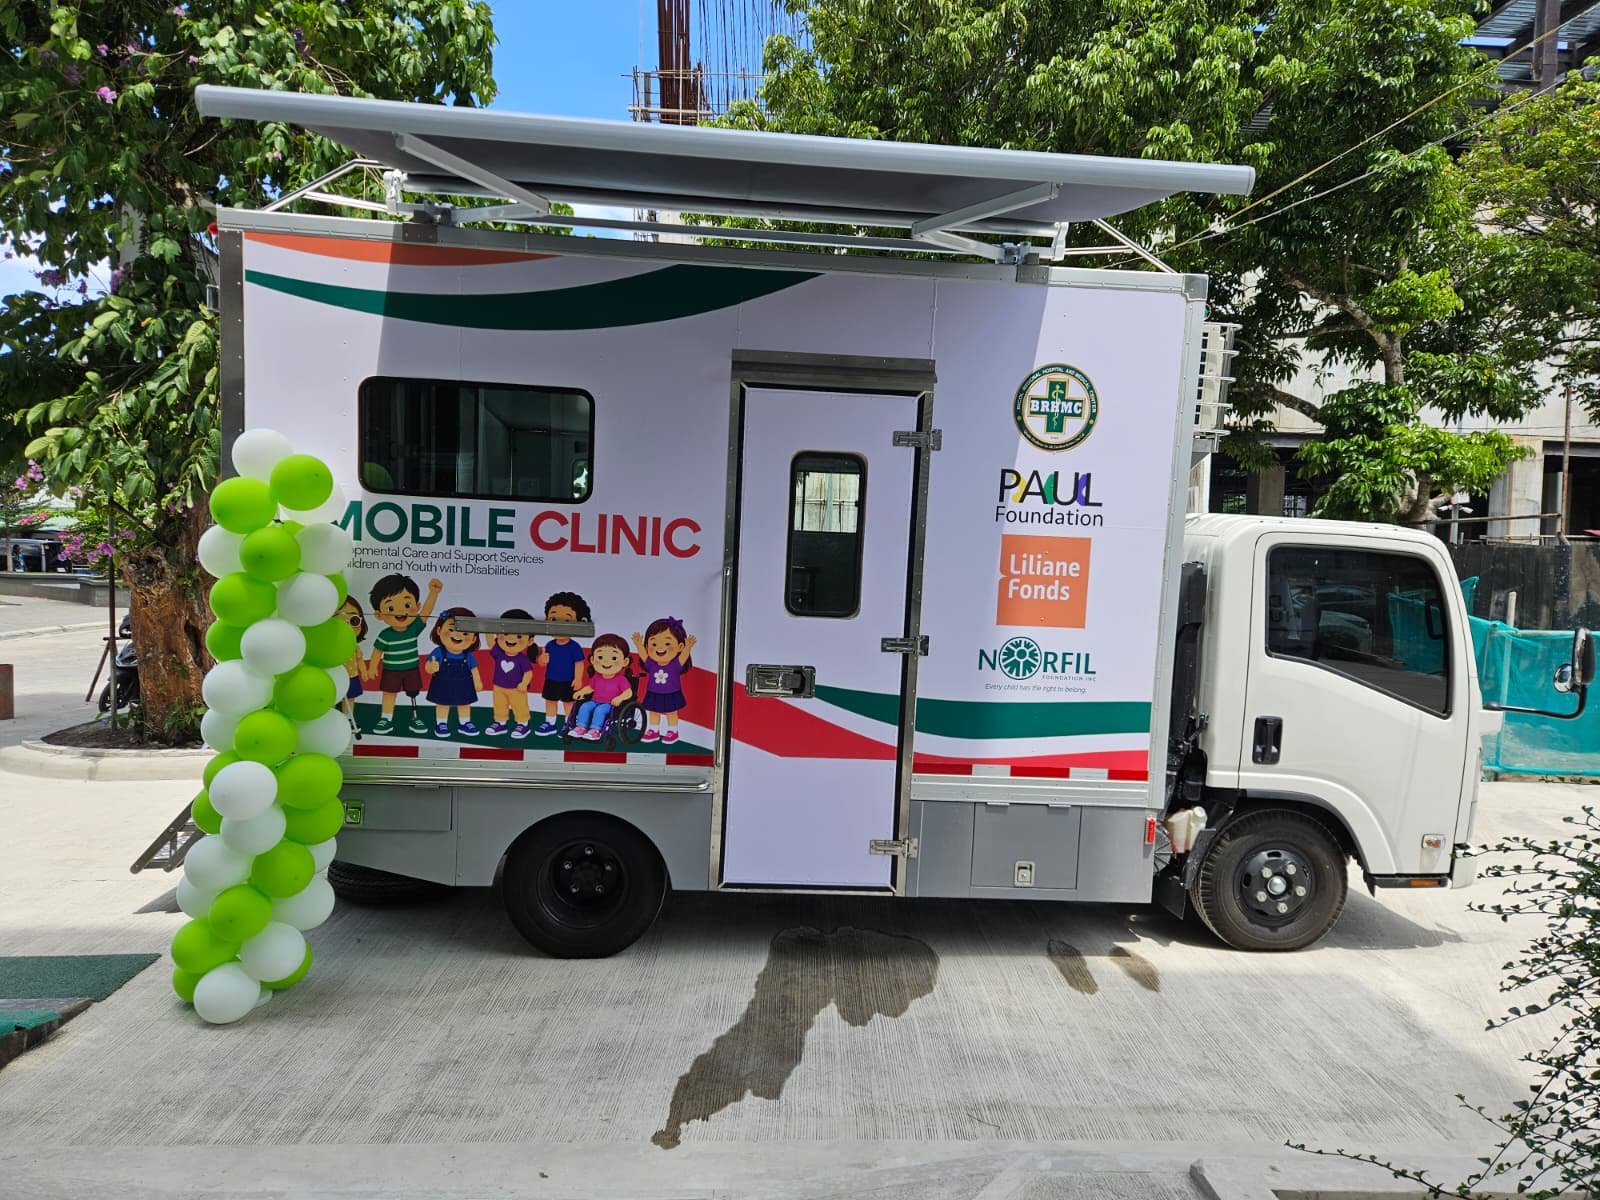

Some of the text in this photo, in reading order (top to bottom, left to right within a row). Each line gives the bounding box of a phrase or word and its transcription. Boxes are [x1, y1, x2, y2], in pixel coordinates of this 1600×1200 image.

[1030, 400, 1082, 414] BRHMC
[998, 468, 1103, 507] PAUL
[995, 505, 1104, 527] Foundation
[330, 500, 702, 558] MOBILE CLINIC
[402, 547, 428, 558] Care
[430, 549, 452, 560] and
[454, 550, 498, 563] Support
[500, 552, 544, 564] Services
[1009, 553, 1081, 577] Liliane
[347, 558, 520, 576] ildren and Youth with Disabilities
[1007, 578, 1071, 601] Fonds
[984, 683, 1003, 691] Every
[1043, 685, 1059, 693] right
